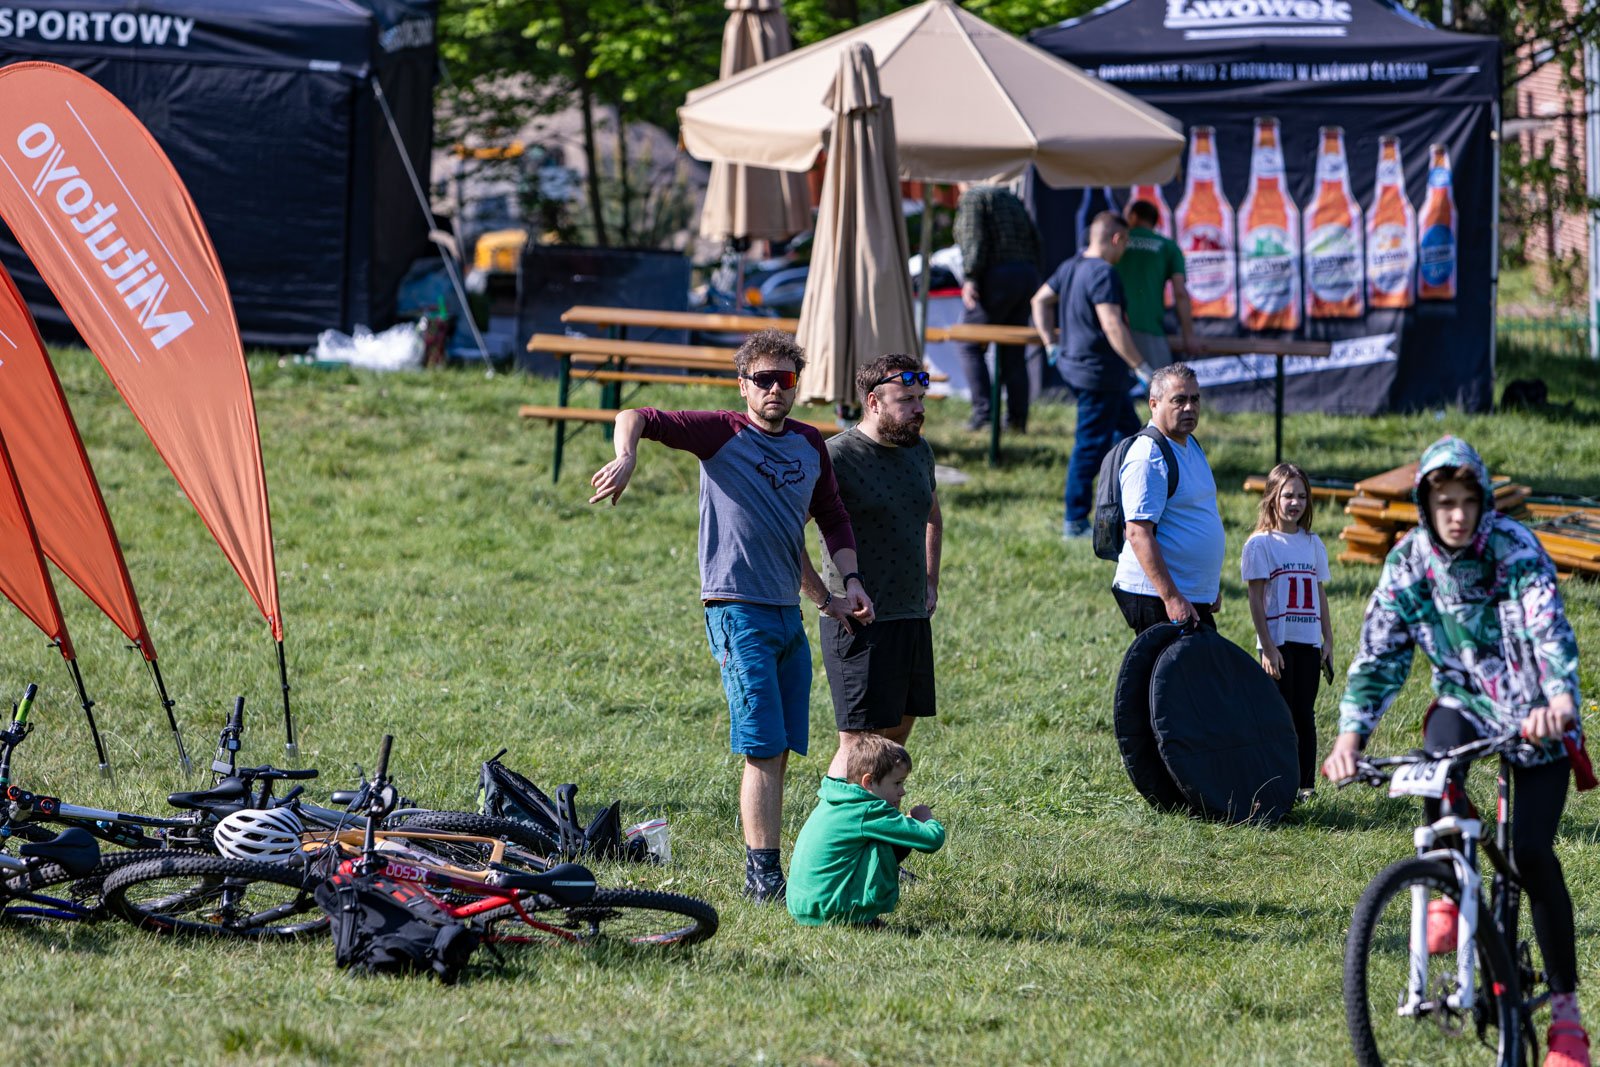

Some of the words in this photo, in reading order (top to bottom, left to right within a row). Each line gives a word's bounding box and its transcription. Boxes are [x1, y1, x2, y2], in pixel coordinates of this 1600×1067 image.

[0, 8, 194, 47] SPORTOWY
[1219, 64, 1228, 80] Z
[1296, 63, 1309, 81] W
[1286, 576, 1315, 609] 11
